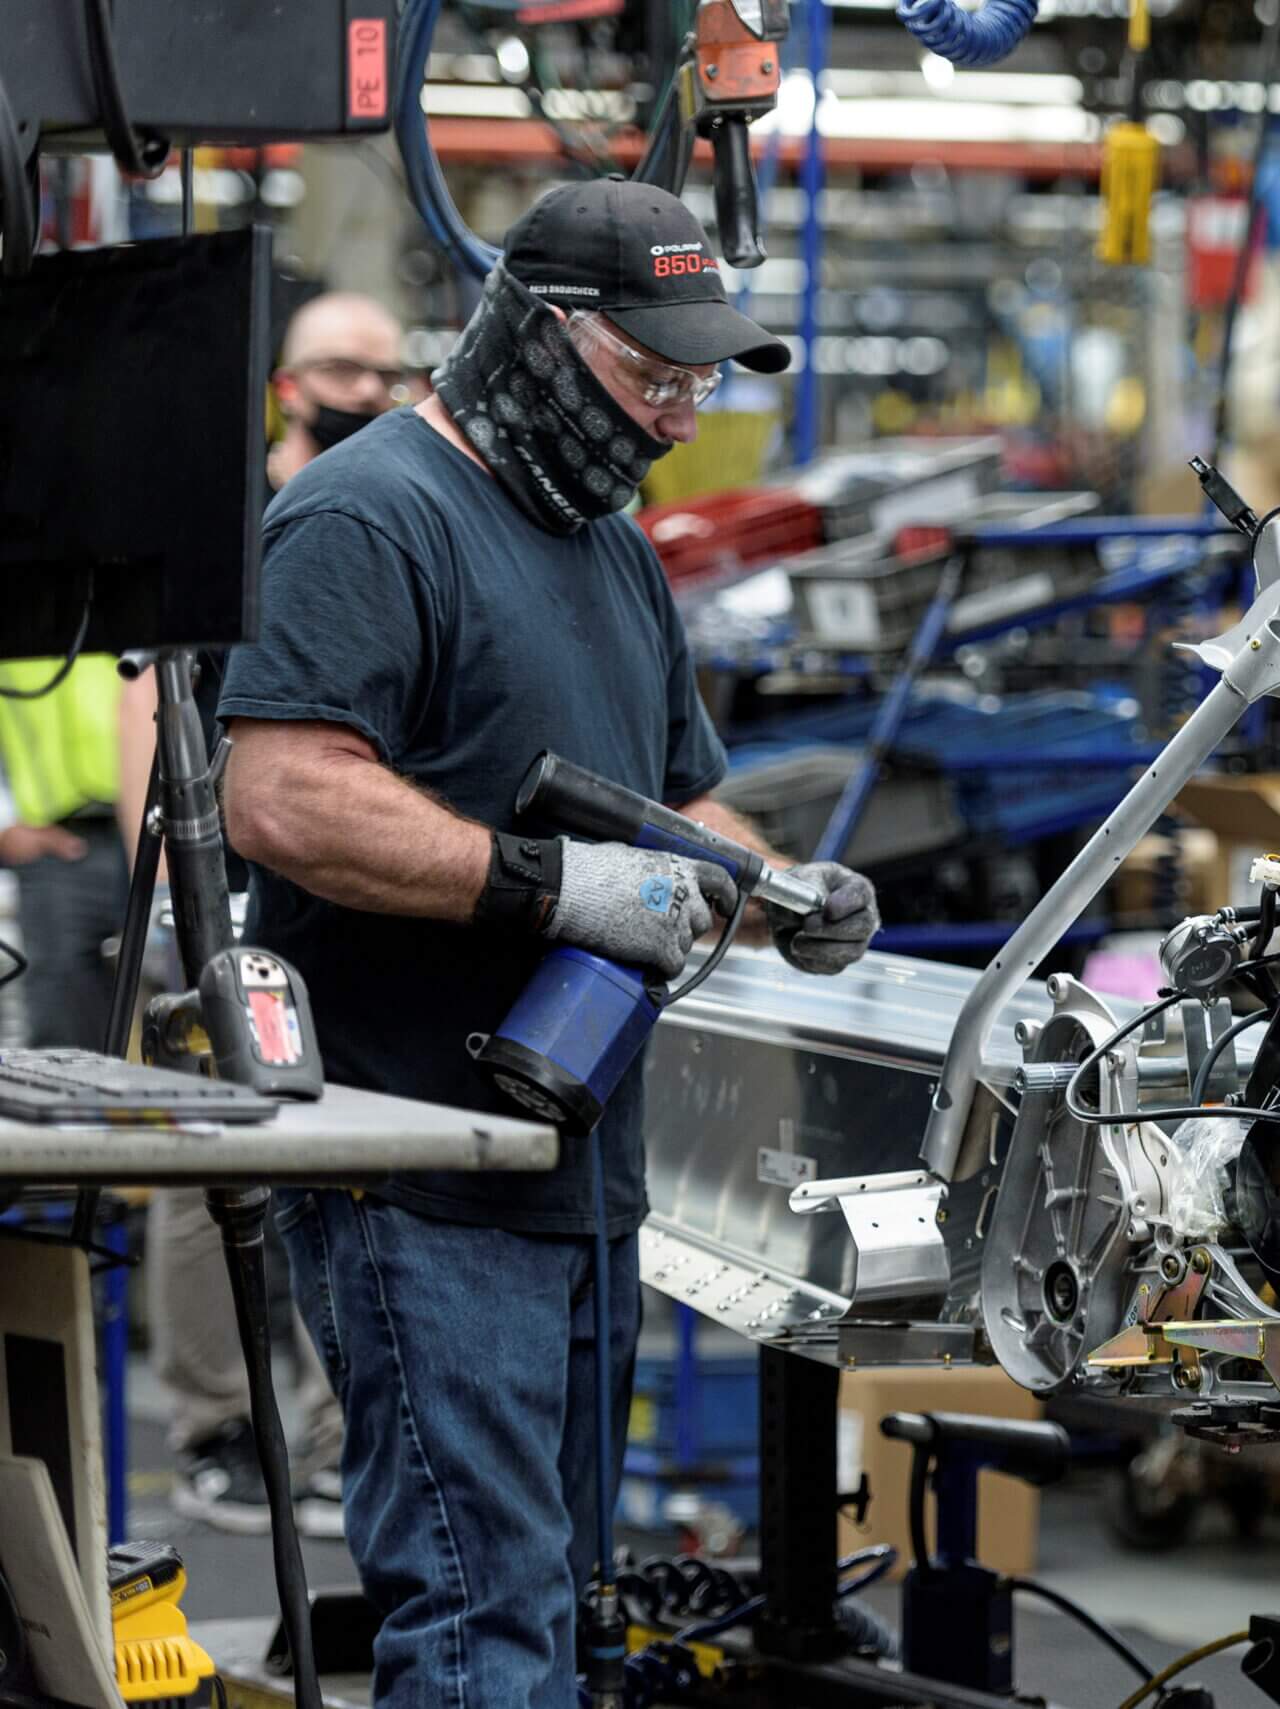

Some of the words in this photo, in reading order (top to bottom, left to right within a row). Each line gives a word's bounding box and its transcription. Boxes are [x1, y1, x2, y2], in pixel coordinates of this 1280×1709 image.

[356, 27, 379, 57] 10
[356, 78, 380, 108] PE
[655, 254, 700, 277] 850
[648, 880, 665, 906] A2
